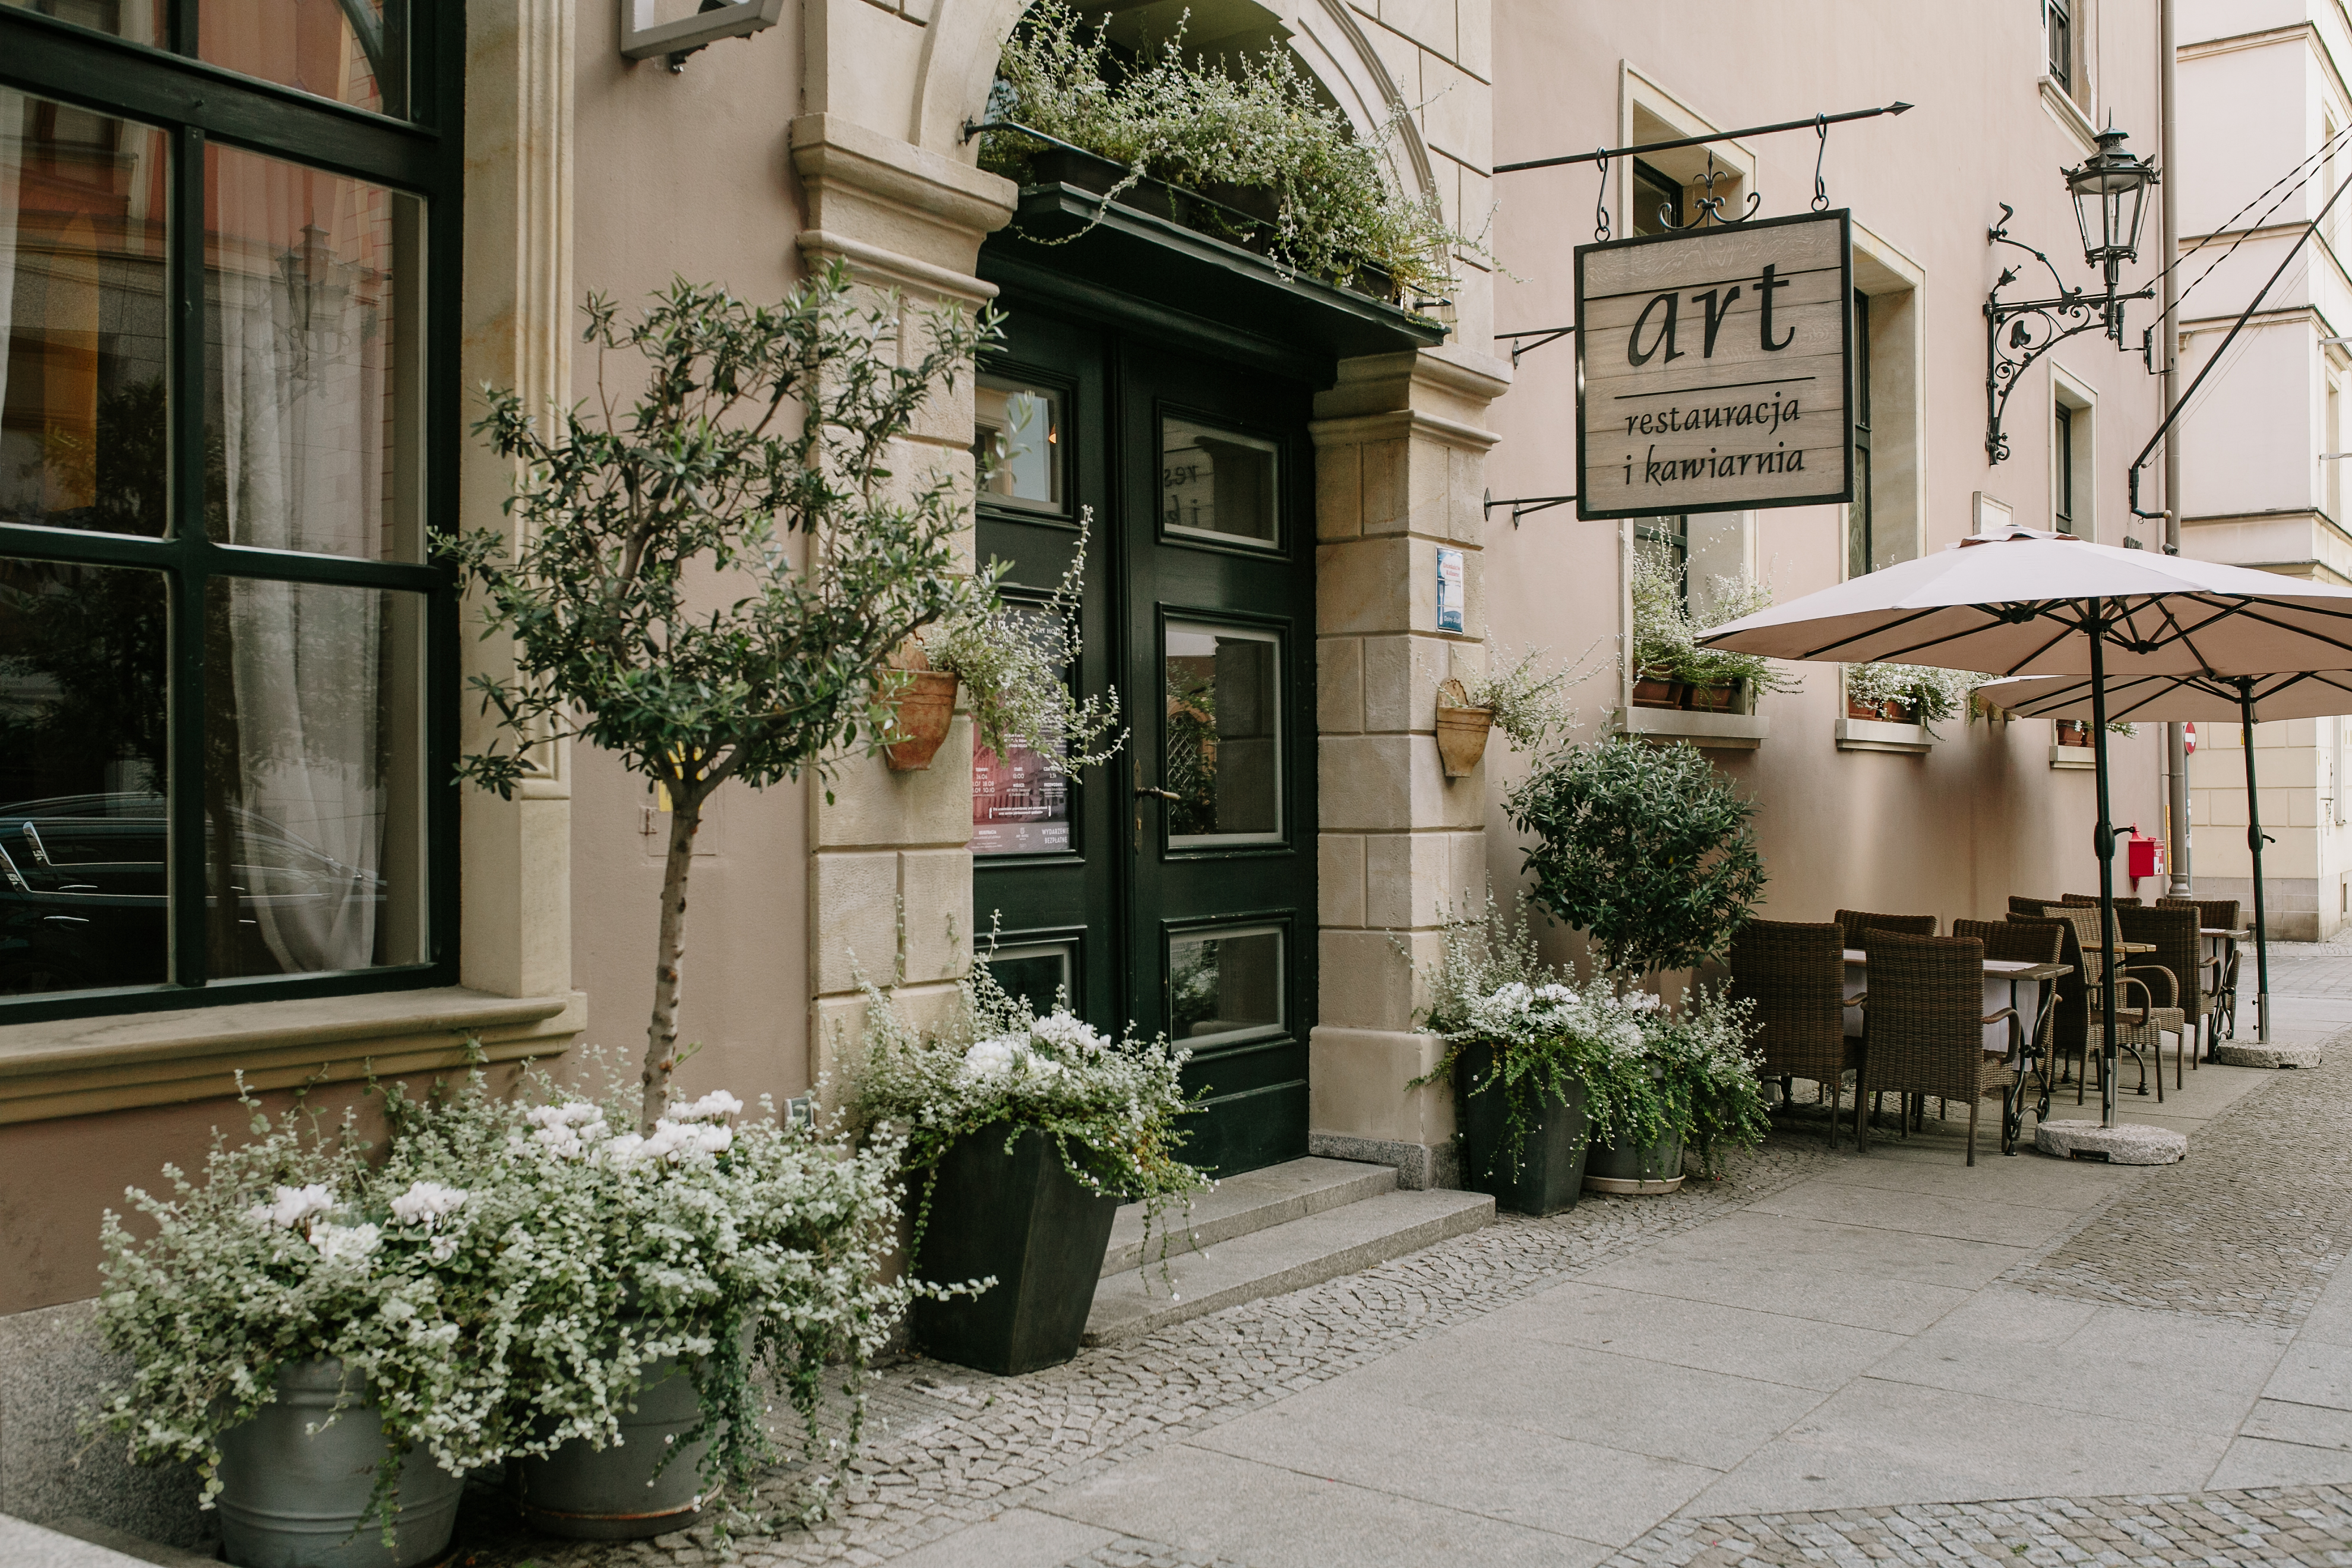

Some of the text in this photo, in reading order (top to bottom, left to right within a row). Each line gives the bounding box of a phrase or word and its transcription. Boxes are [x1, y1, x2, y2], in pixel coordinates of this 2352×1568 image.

[1627, 264, 1795, 366] art
[1624, 391, 1800, 435] restauracja
[1623, 441, 1804, 486] i kawiarnia
